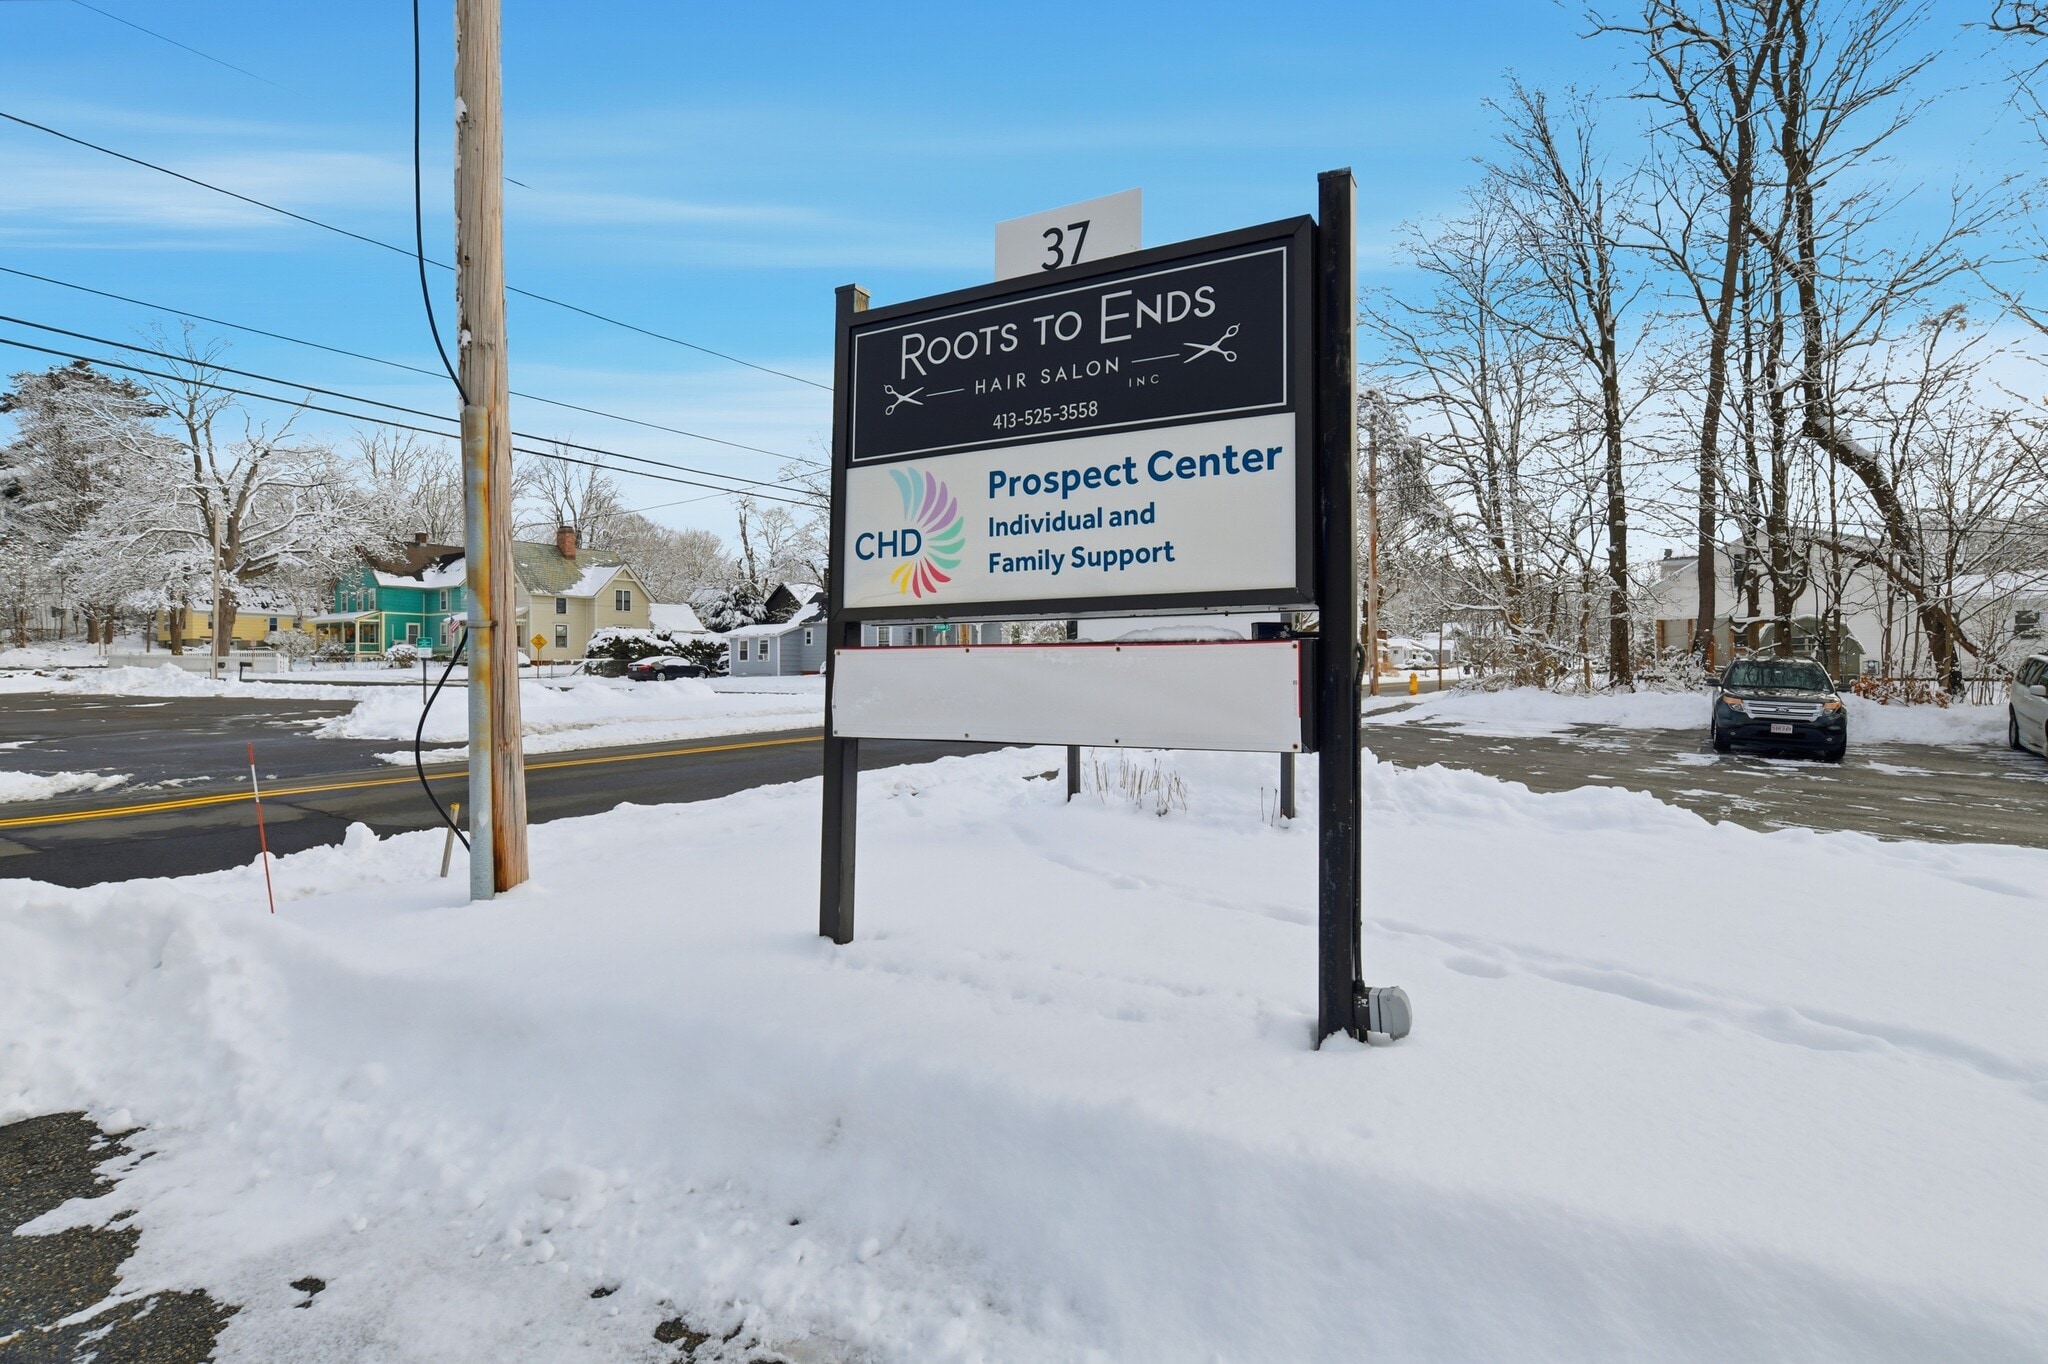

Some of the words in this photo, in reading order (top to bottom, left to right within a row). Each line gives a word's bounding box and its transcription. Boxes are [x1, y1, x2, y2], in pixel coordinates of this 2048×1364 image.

[1041, 219, 1091, 271] 37
[1033, 311, 1082, 346] TO
[975, 372, 1026, 395] HAIR
[1040, 356, 1119, 384] SALON
[1128, 373, 1160, 388] INC
[992, 400, 1098, 430] 413-525-3558
[988, 456, 1139, 499] Prospect
[1147, 444, 1283, 482] Center
[988, 506, 1103, 538] Individual
[1108, 501, 1155, 528] and
[855, 528, 922, 561] CHD
[988, 548, 1066, 576] Family
[1070, 540, 1176, 573] Support
